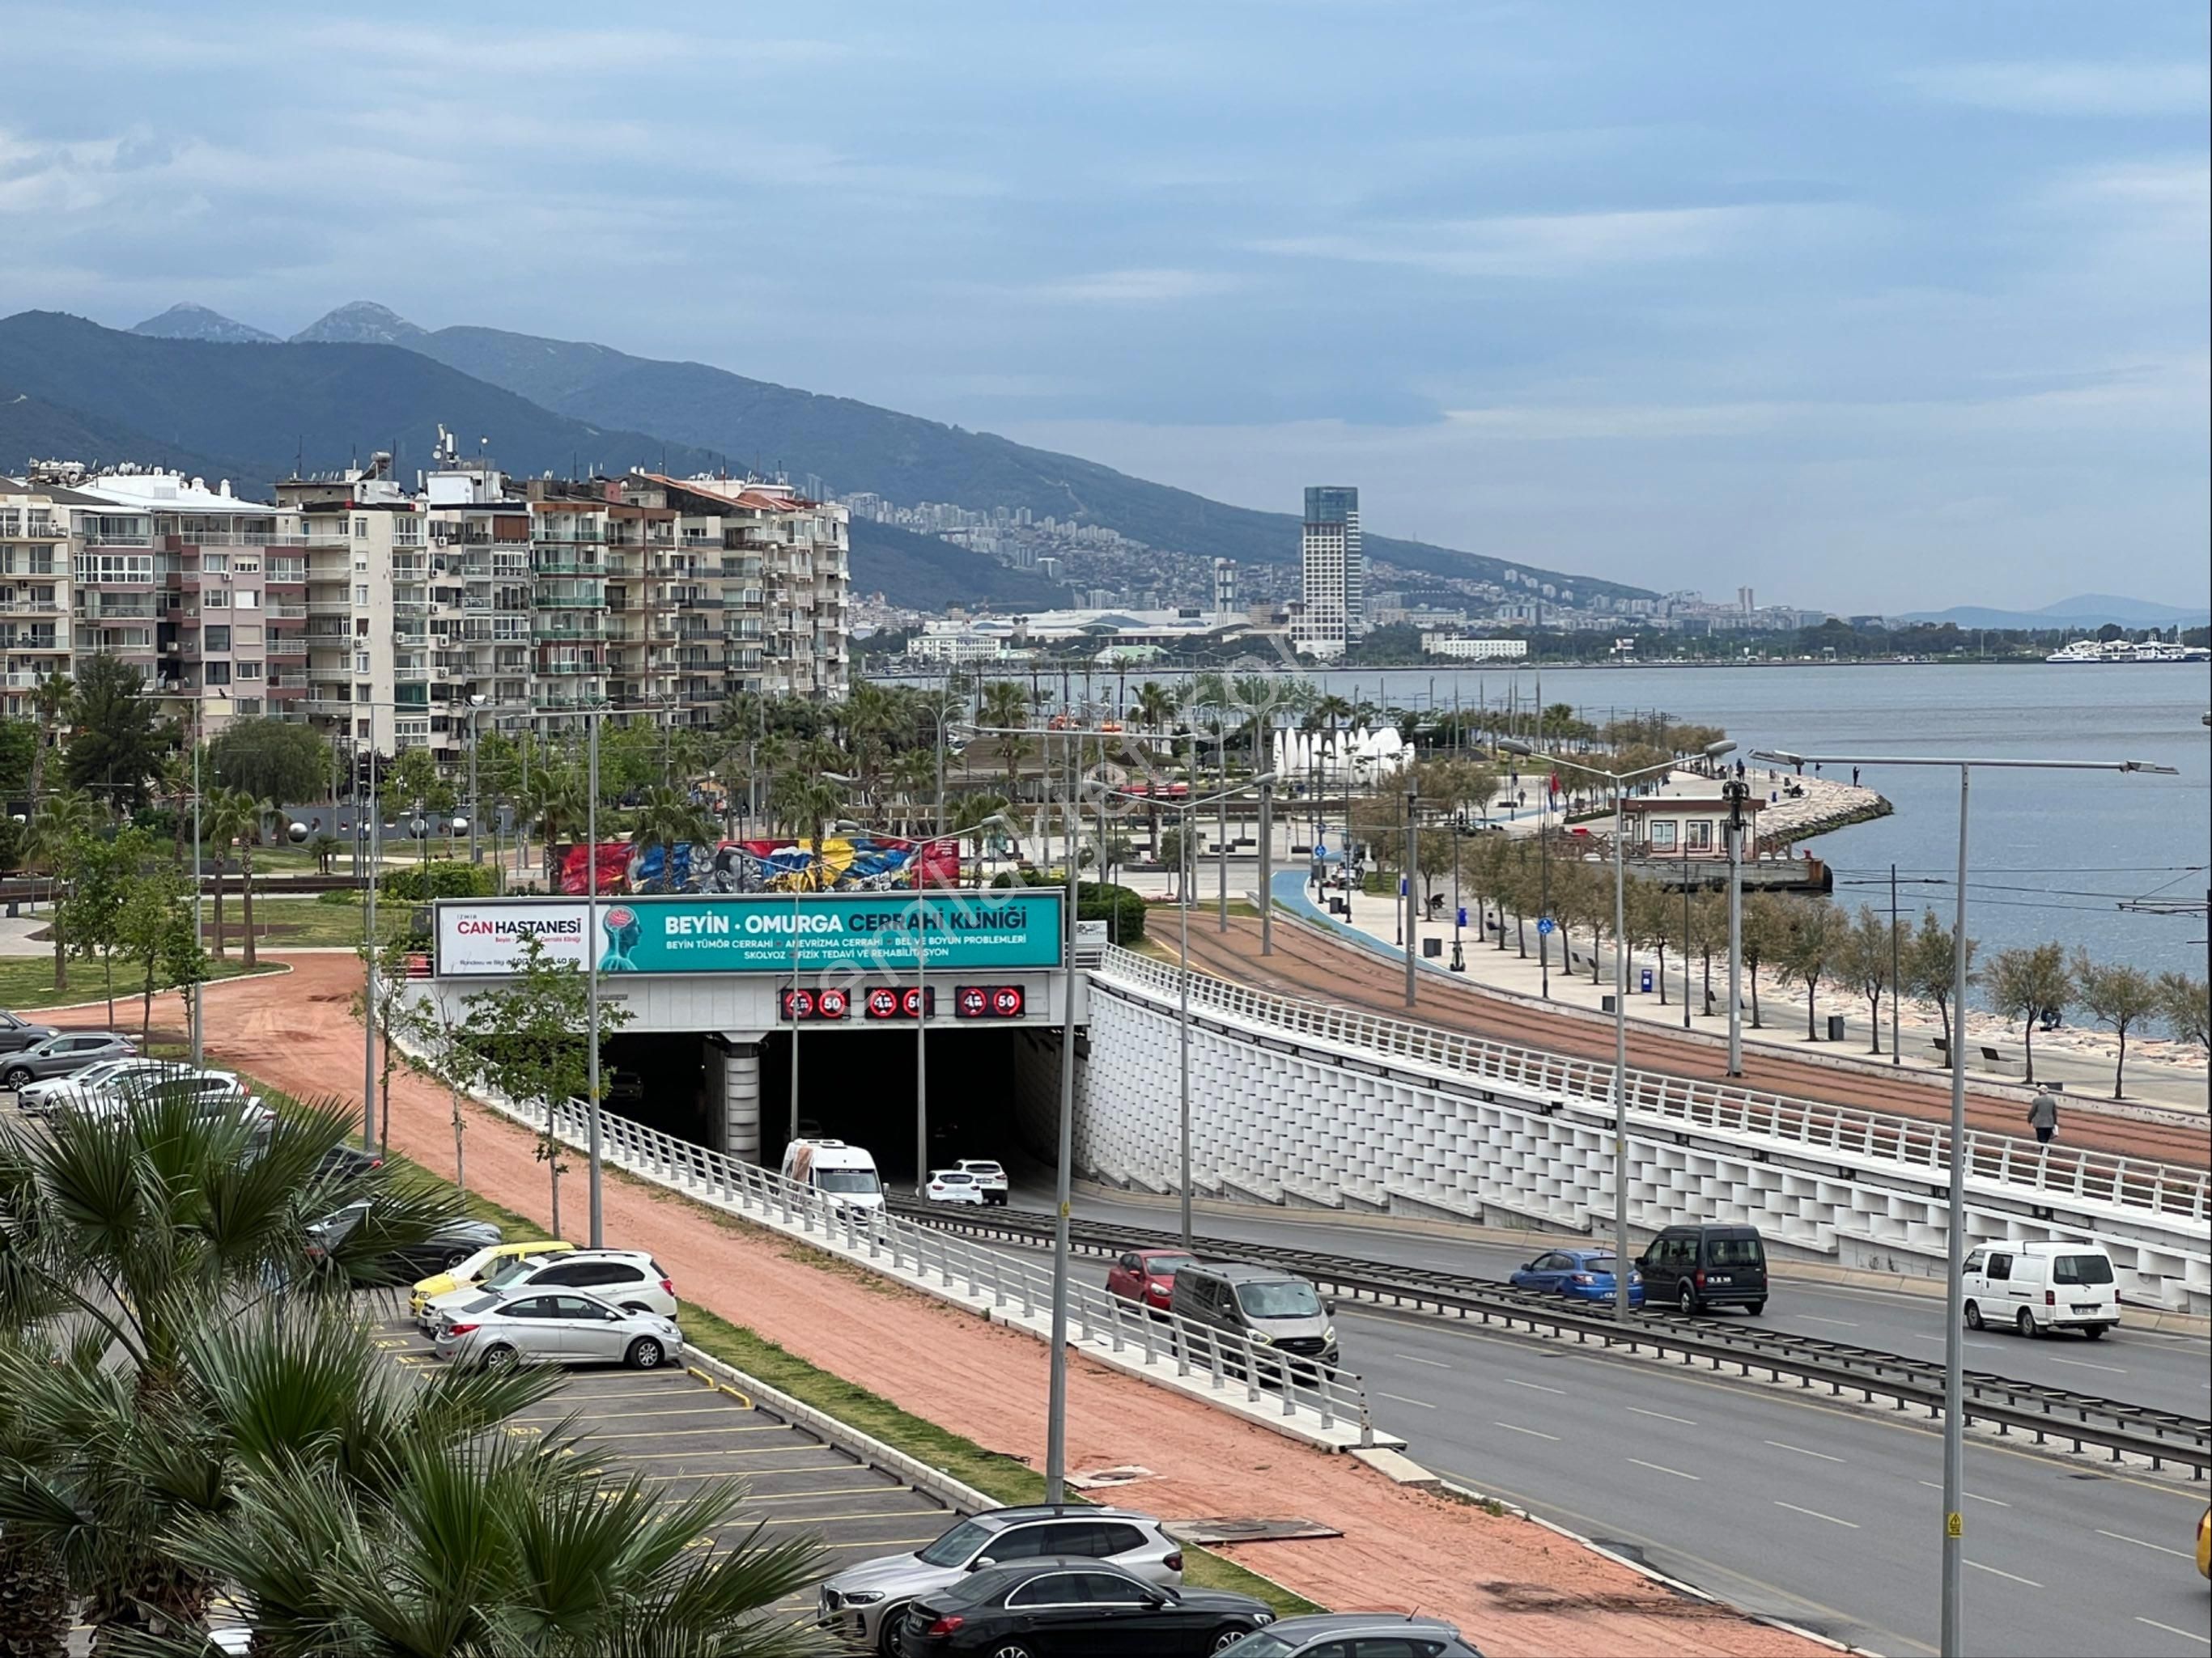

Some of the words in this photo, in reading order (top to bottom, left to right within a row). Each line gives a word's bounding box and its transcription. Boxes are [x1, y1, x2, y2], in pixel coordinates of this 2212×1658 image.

[457, 921, 493, 935] CAN
[495, 918, 582, 934] HASTANESİ
[664, 910, 729, 935] BEYİN
[745, 914, 844, 934] OMURGA
[848, 906, 945, 931] CERRAHİ
[949, 905, 1027, 929] KLİNİĞİ
[666, 939, 694, 949] BEYİN
[696, 939, 729, 948] TÜMÖR
[732, 938, 774, 948] CERRAHİ
[842, 936, 884, 947] CERRAHİ
[895, 937, 912, 946] BEL
[928, 935, 962, 945] BOYUN
[963, 933, 1027, 944] PROBLEMLERİ
[744, 950, 786, 960] SKOLYOZ
[796, 948, 820, 959] FİZİK
[822, 948, 856, 958] TEDAVİ
[856, 949, 870, 958] VE
[824, 997, 841, 1010] 50
[998, 994, 1016, 1007] 50
